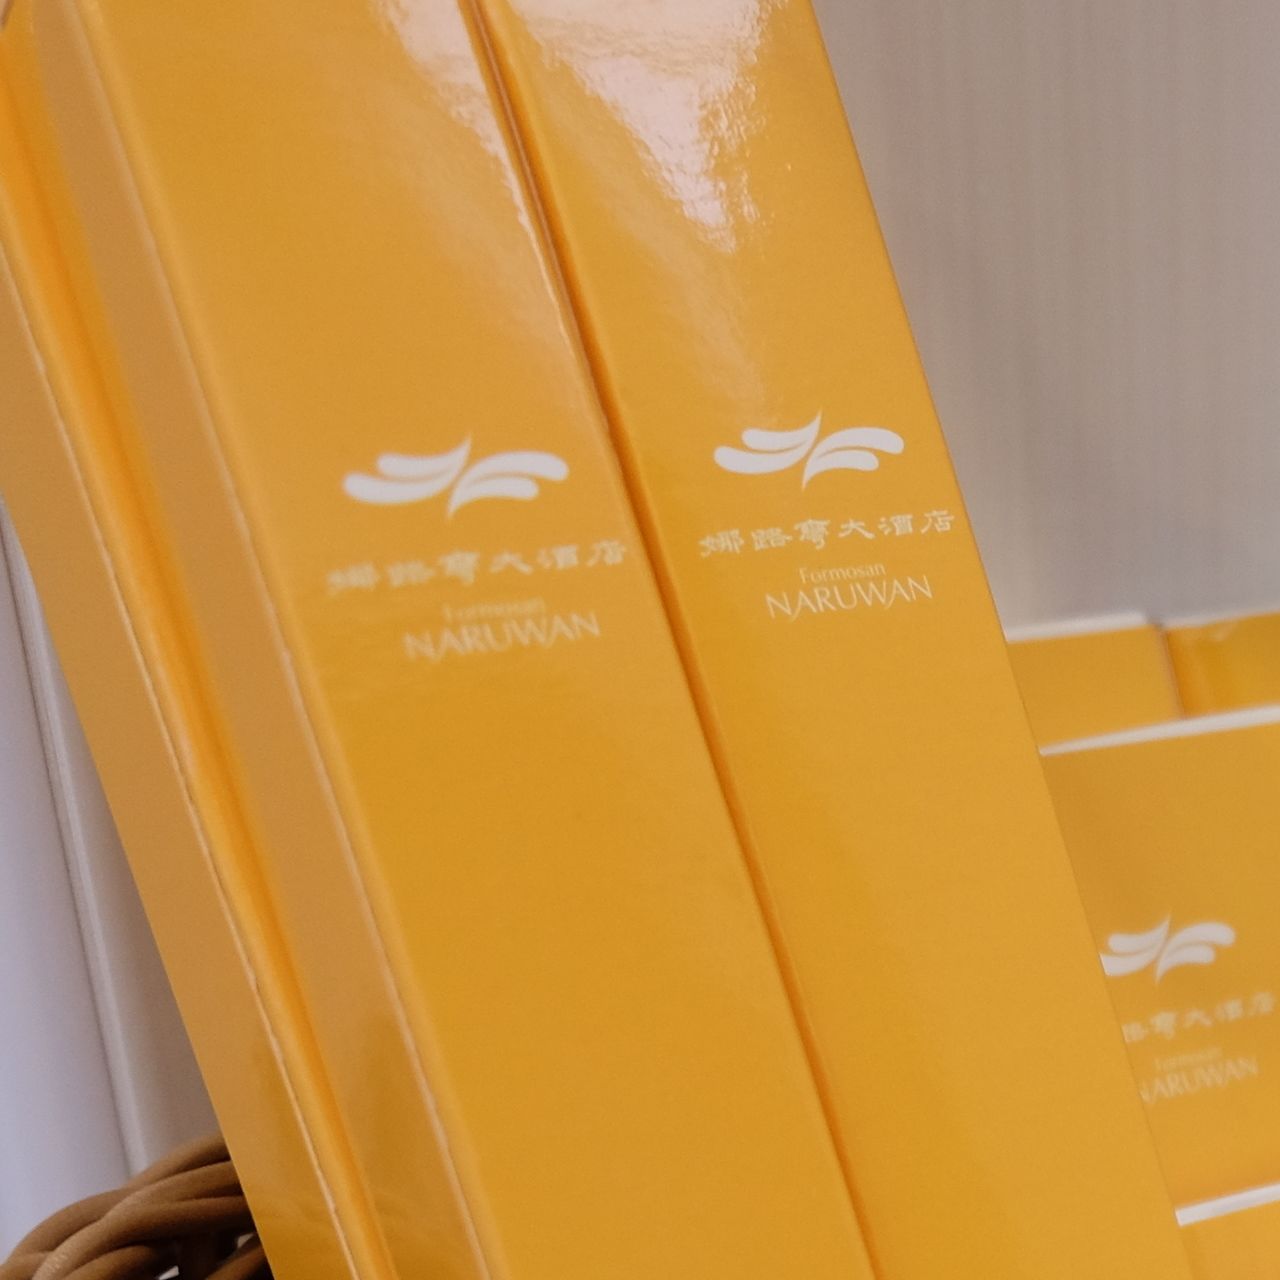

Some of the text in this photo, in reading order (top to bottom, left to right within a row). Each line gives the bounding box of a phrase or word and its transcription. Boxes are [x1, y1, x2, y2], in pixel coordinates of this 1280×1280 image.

[764, 574, 935, 624] NARUWAN
[797, 563, 887, 585] Formosan
[402, 610, 602, 664] NARUWAN
